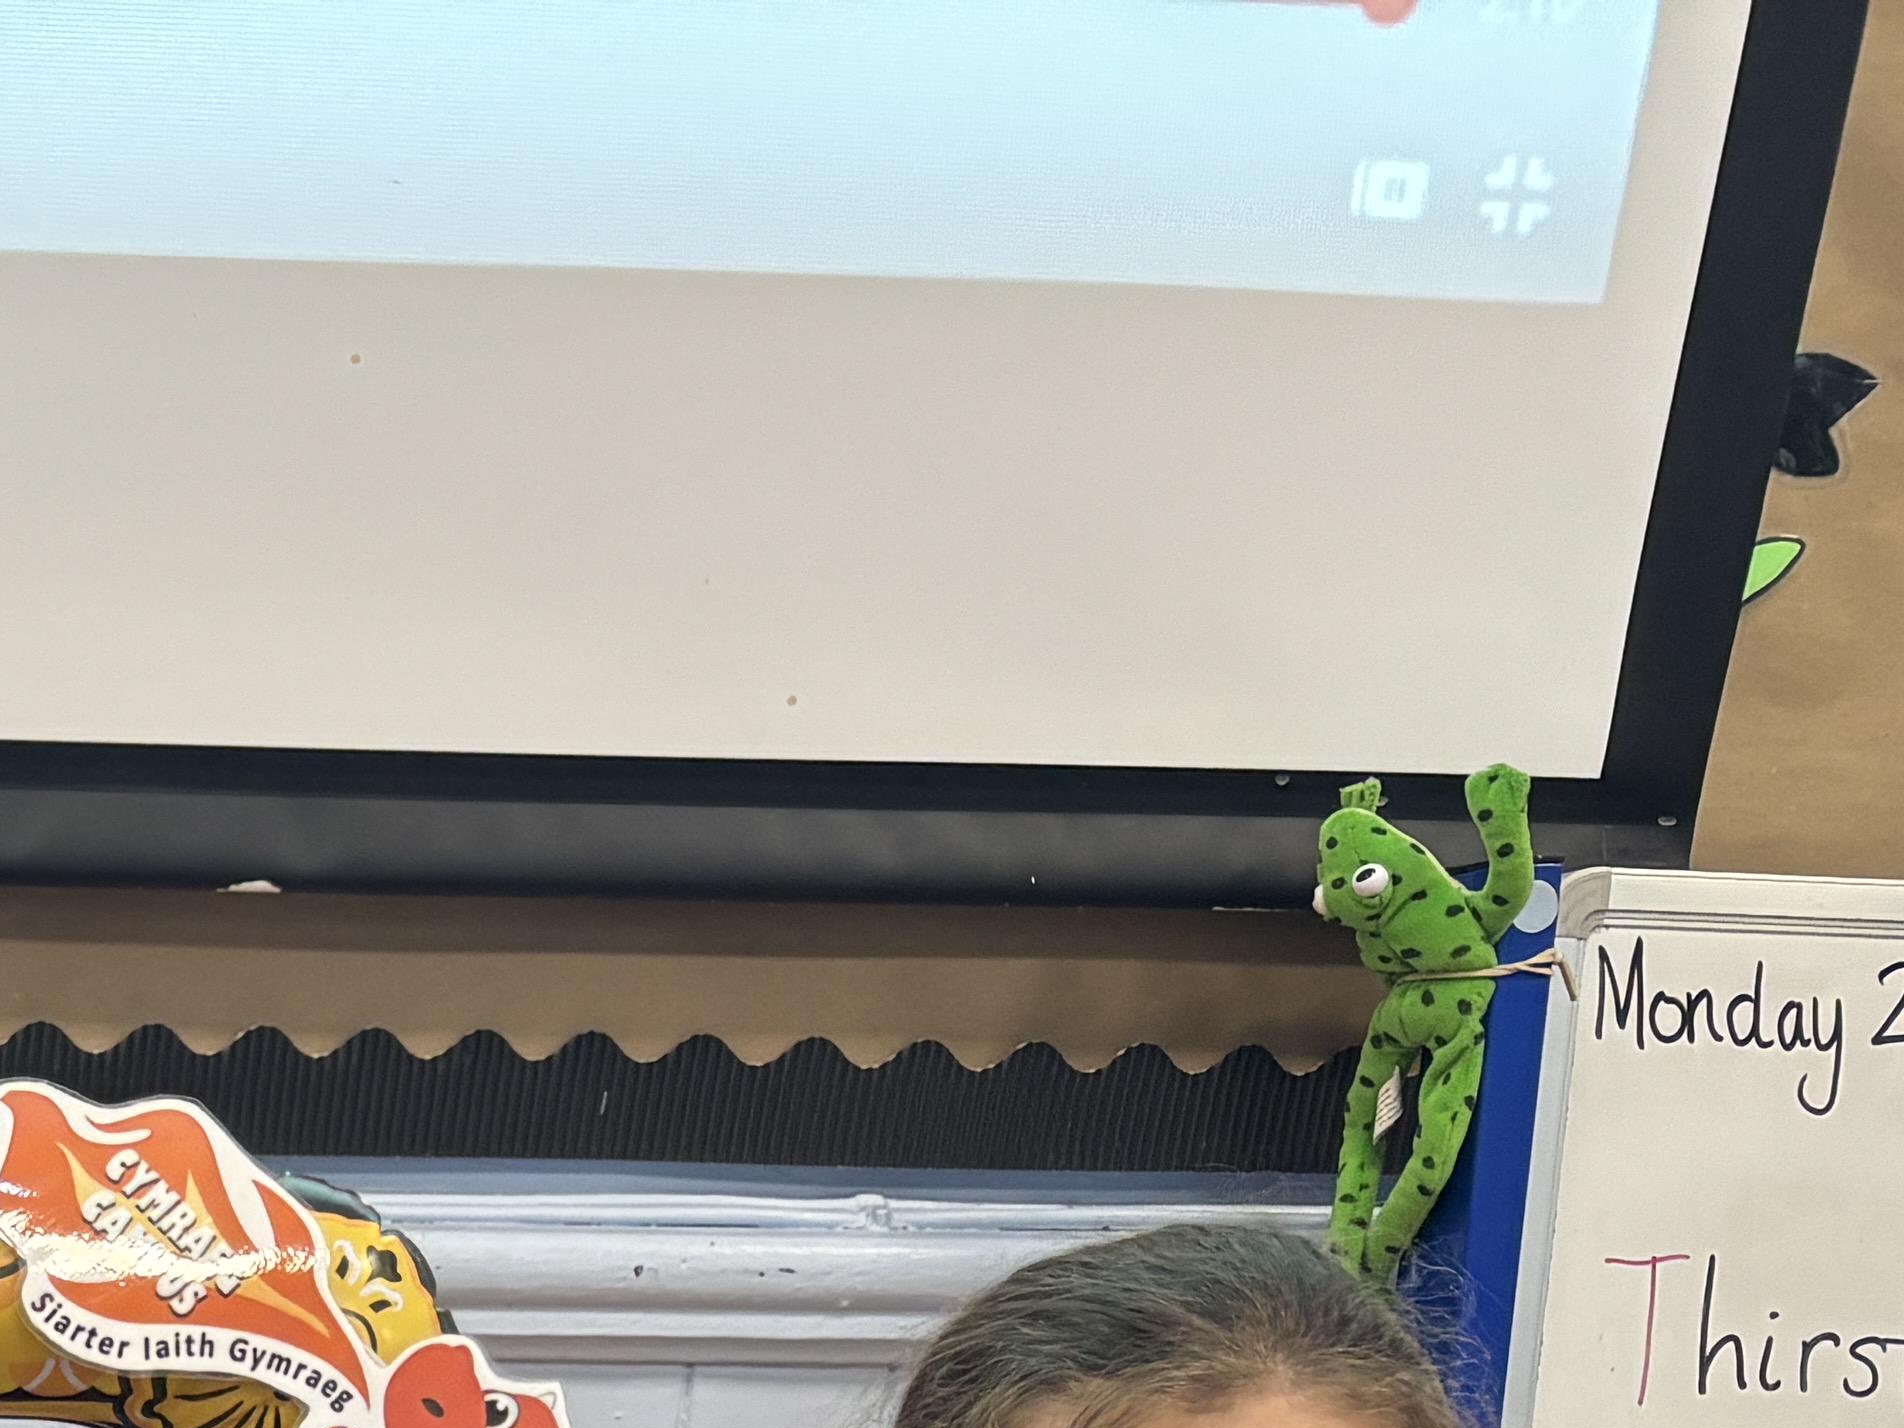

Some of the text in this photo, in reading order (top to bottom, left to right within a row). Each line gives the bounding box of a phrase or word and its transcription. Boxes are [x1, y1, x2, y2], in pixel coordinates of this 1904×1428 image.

[1595, 936, 1843, 1115] Monday
[31, 1292, 355, 1414] Siarter Iaith Gymraeg
